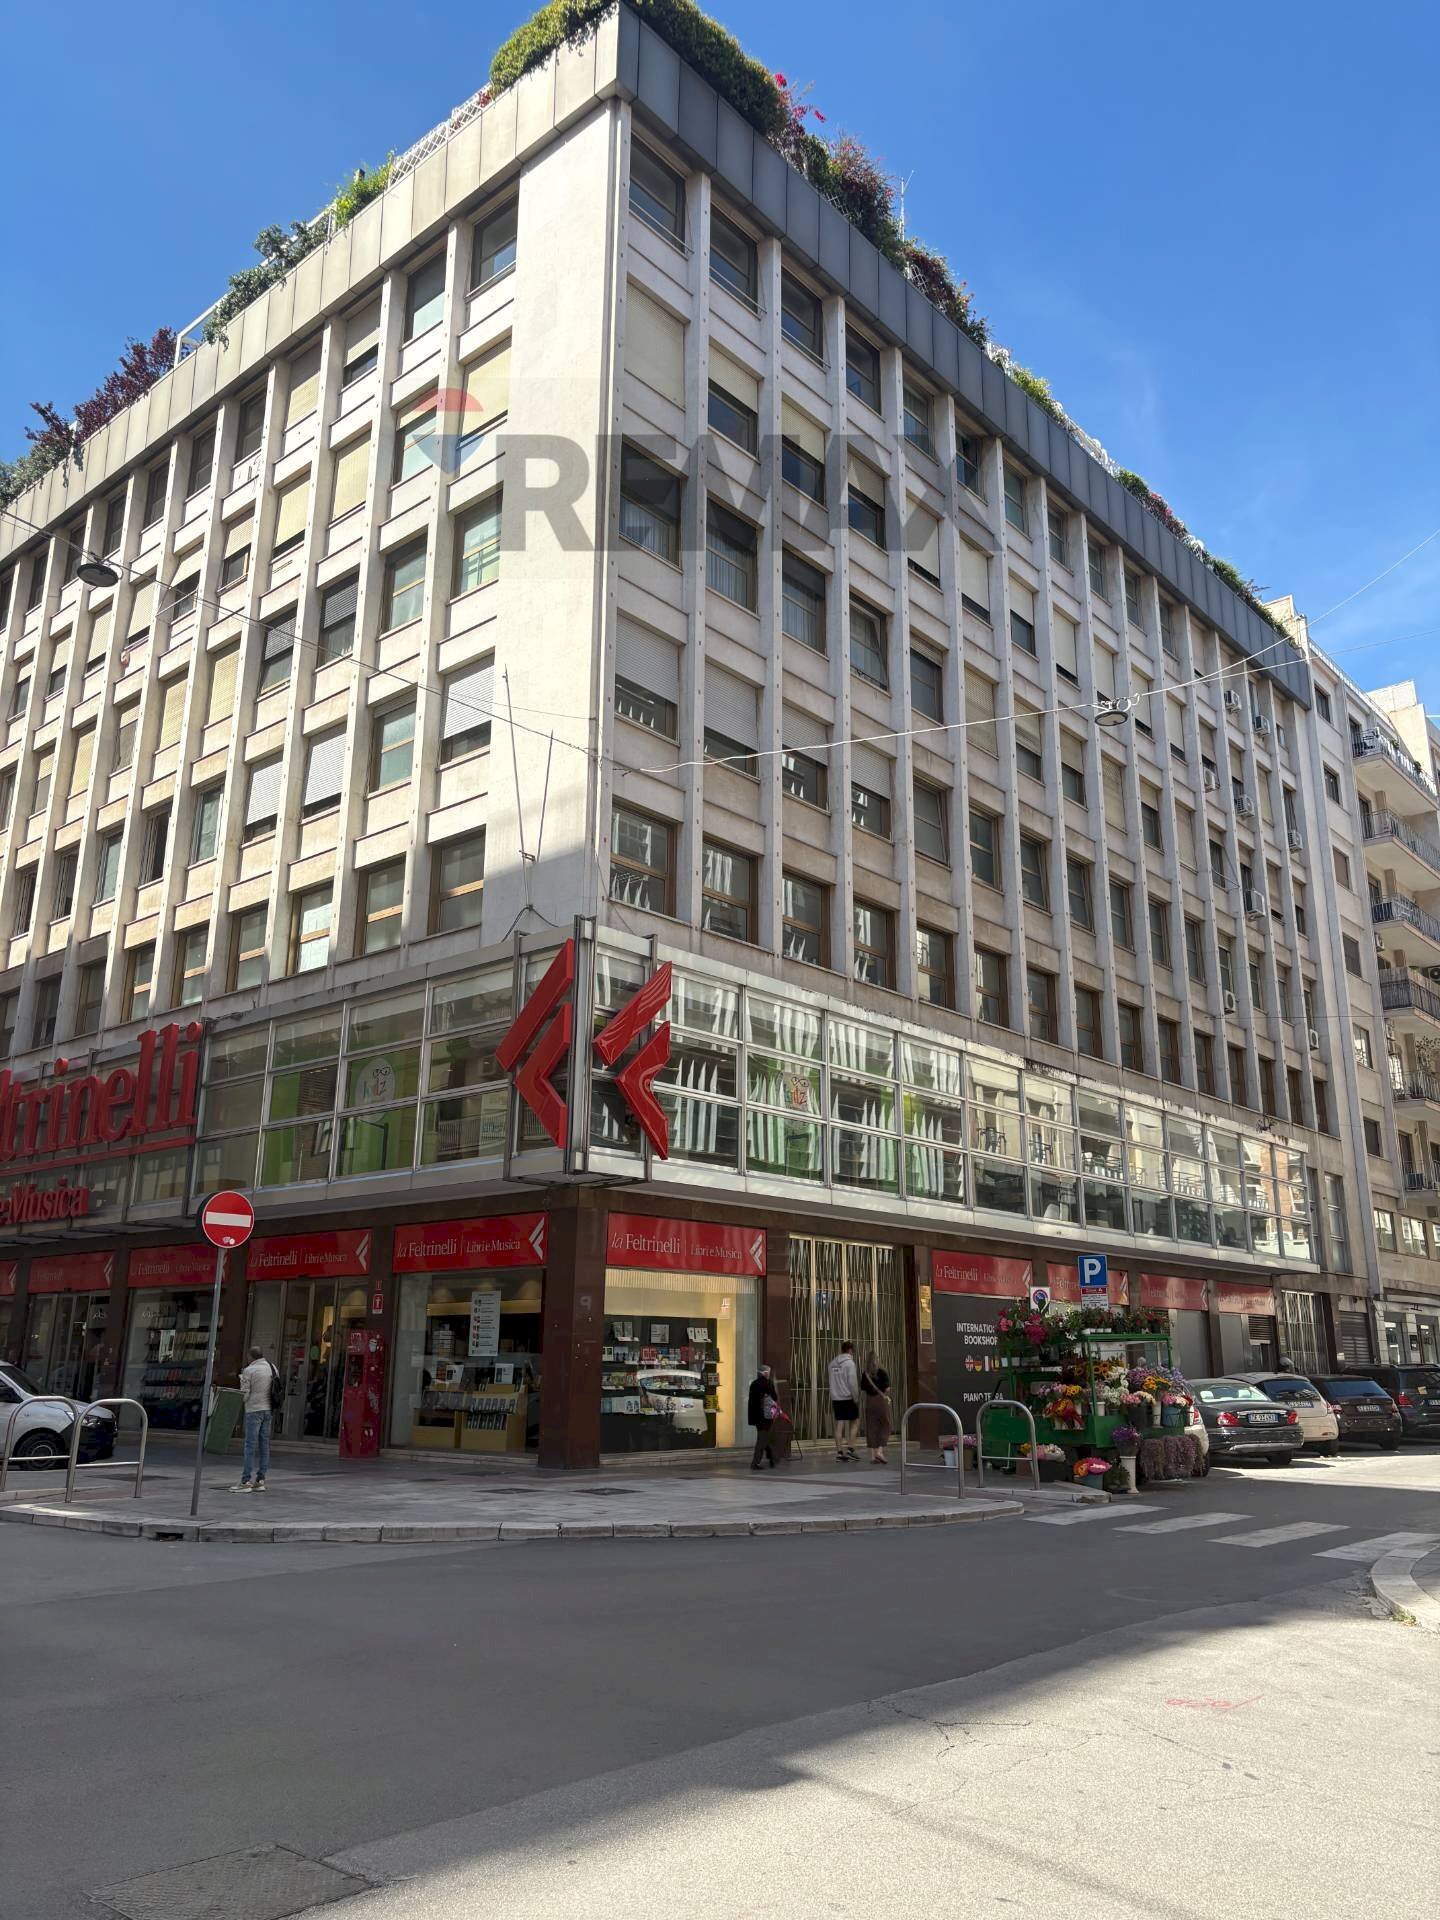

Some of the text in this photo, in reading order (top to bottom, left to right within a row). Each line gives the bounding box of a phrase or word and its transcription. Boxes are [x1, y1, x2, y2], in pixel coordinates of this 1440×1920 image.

[409, 1239, 457, 1257] Feltrinelli
[611, 1232, 623, 1249] la
[626, 1233, 681, 1254] Feltrinelli
[1083, 1258, 1102, 1284] P
[986, 1393, 1003, 1403] TERA
